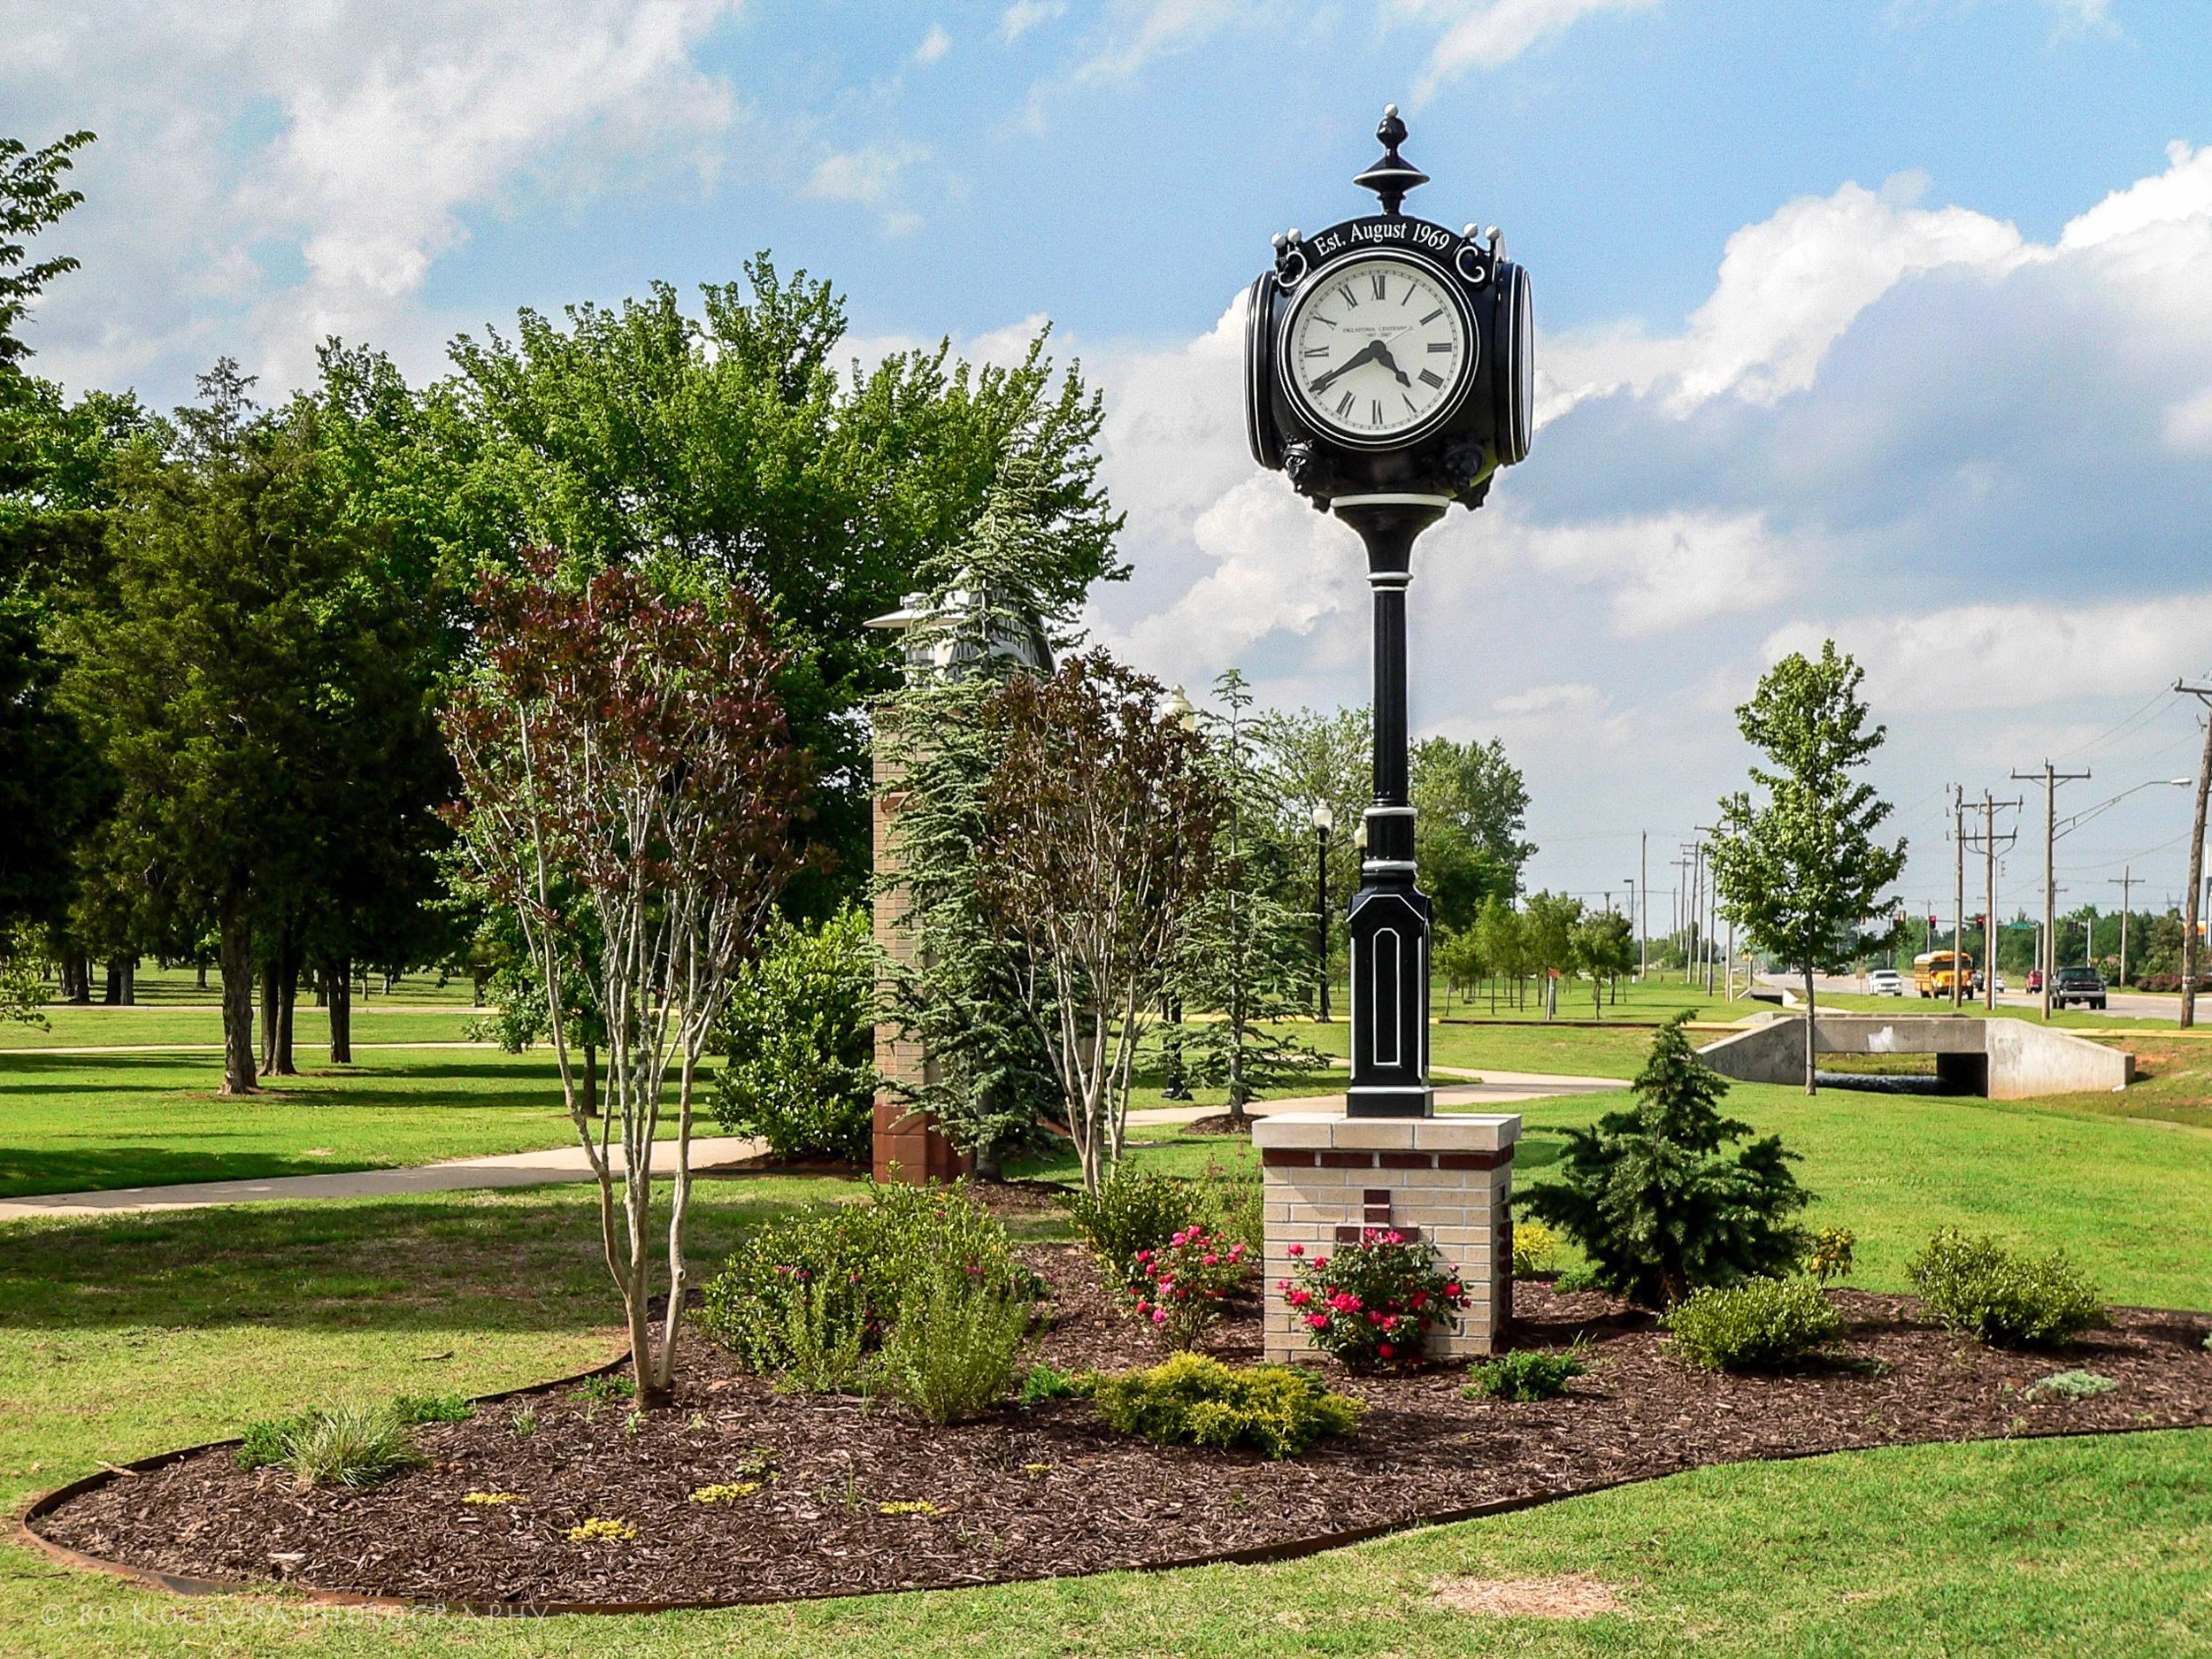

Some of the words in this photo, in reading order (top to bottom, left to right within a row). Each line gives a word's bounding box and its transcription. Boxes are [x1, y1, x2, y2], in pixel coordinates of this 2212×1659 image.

[1350, 222, 1408, 243] August
[1412, 223, 1450, 250] 1969
[1371, 274, 1386, 301] XII
